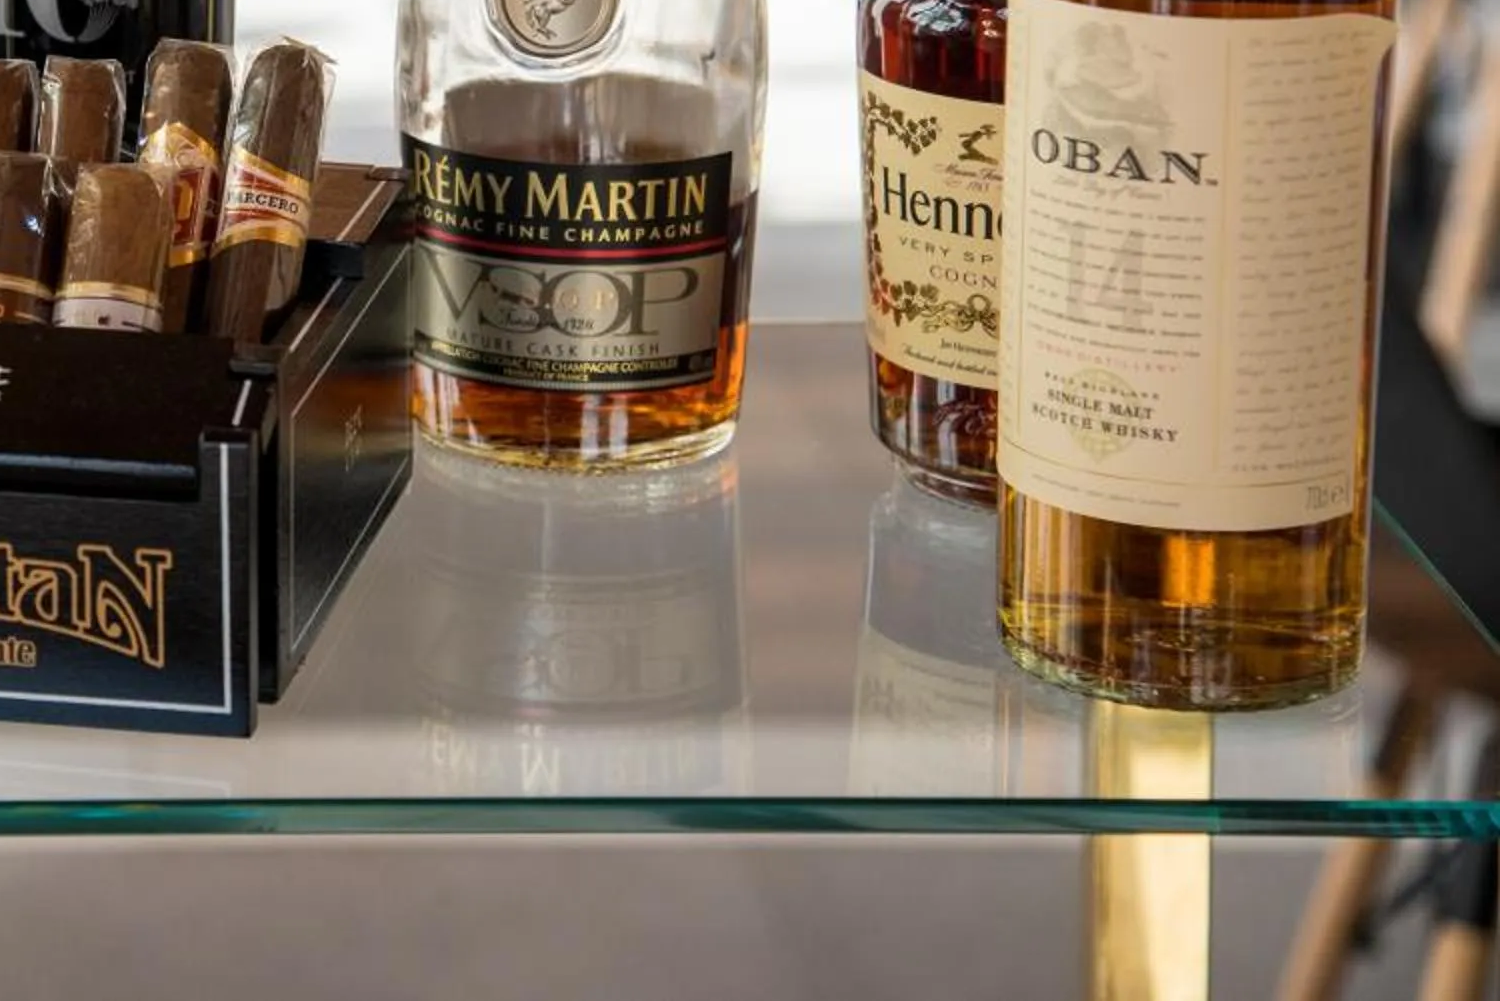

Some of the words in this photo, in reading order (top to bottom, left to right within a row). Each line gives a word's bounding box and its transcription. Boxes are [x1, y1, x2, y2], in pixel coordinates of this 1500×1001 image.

[1031, 128, 1210, 186] OBAN
[414, 148, 514, 215] RÉMY
[523, 170, 708, 223] MARTIN
[882, 166, 1003, 241] Henn
[495, 221, 550, 240] FINE
[563, 219, 705, 244] CHAMPAGNE
[898, 234, 950, 257] VERY
[414, 242, 700, 338] VSOP
[526, 341, 579, 358] CASK
[591, 343, 661, 358] FINISH
[551, 360, 620, 375] CHAMPAGNE
[1048, 388, 1103, 413] SINGLE
[1108, 401, 1155, 420] MALT
[1031, 402, 1094, 431] SCOTCH
[1100, 419, 1180, 443] WHISKY
